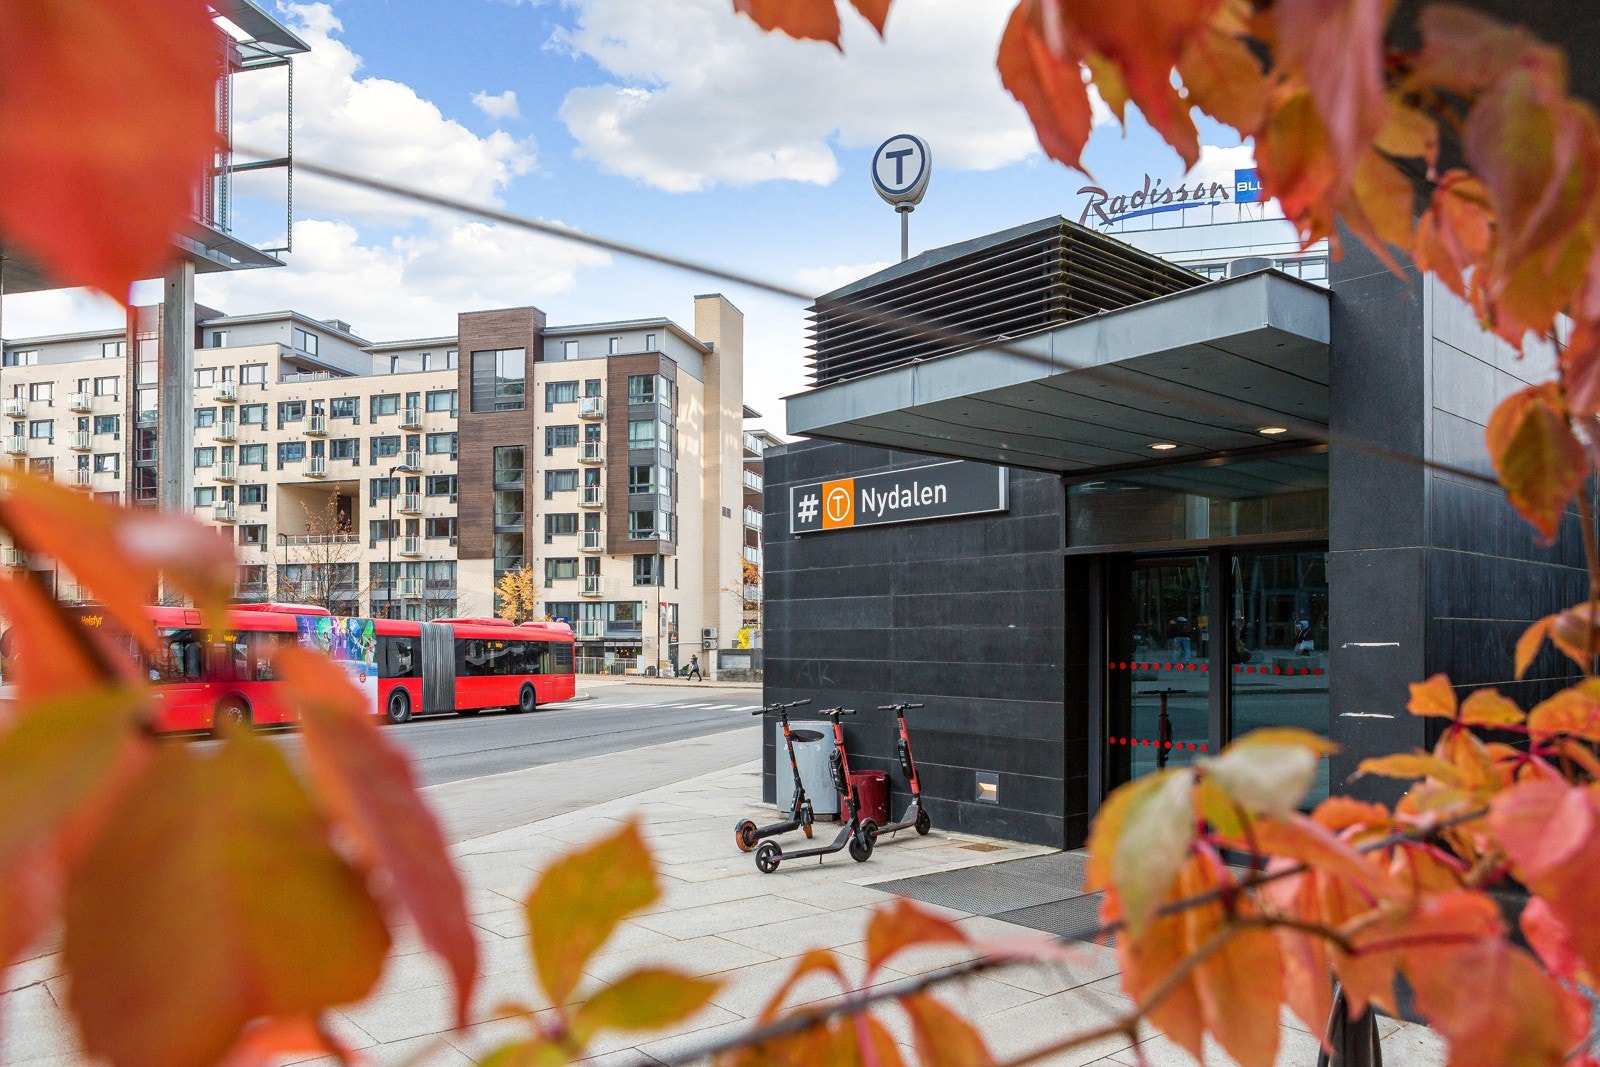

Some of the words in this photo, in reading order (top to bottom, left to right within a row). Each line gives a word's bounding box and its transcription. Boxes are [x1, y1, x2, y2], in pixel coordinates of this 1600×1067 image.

[885, 148, 914, 185] T
[1076, 173, 1230, 226] Radisson
[861, 481, 948, 518] Nydalen
